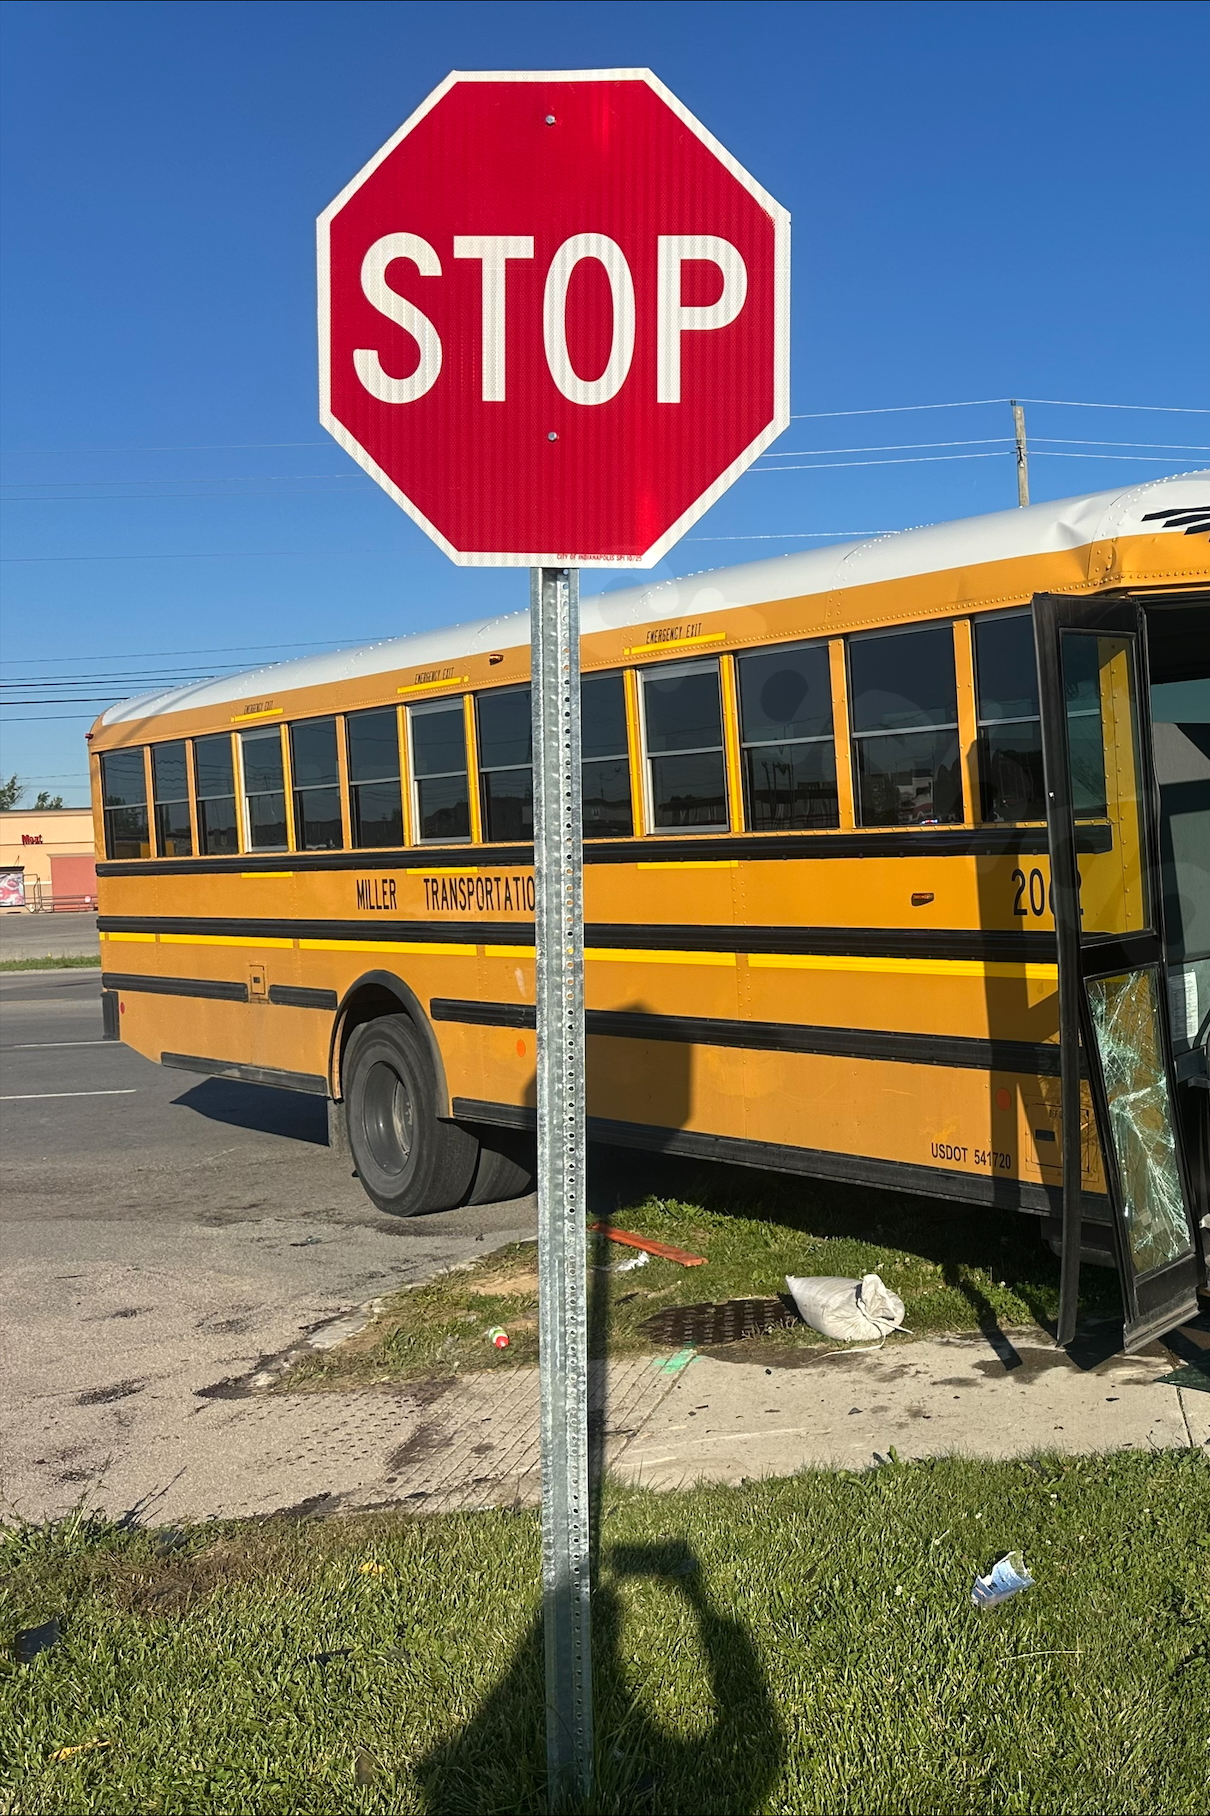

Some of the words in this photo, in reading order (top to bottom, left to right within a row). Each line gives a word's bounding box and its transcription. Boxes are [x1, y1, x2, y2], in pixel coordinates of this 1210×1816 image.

[353, 232, 749, 406] STOP
[578, 554, 615, 562] INDIANAPOLIS
[646, 626, 683, 645] EMERGENCY
[686, 622, 702, 639] EXIT
[415, 669, 441, 685] EMERGENCY
[443, 667, 455, 680] EXIT
[356, 878, 397, 910] MILLER
[423, 876, 536, 911] TRANSPORTATIO
[1011, 868, 1084, 917] 20
[931, 1142, 968, 1163] USDOT
[974, 1149, 1011, 1170] 541720
